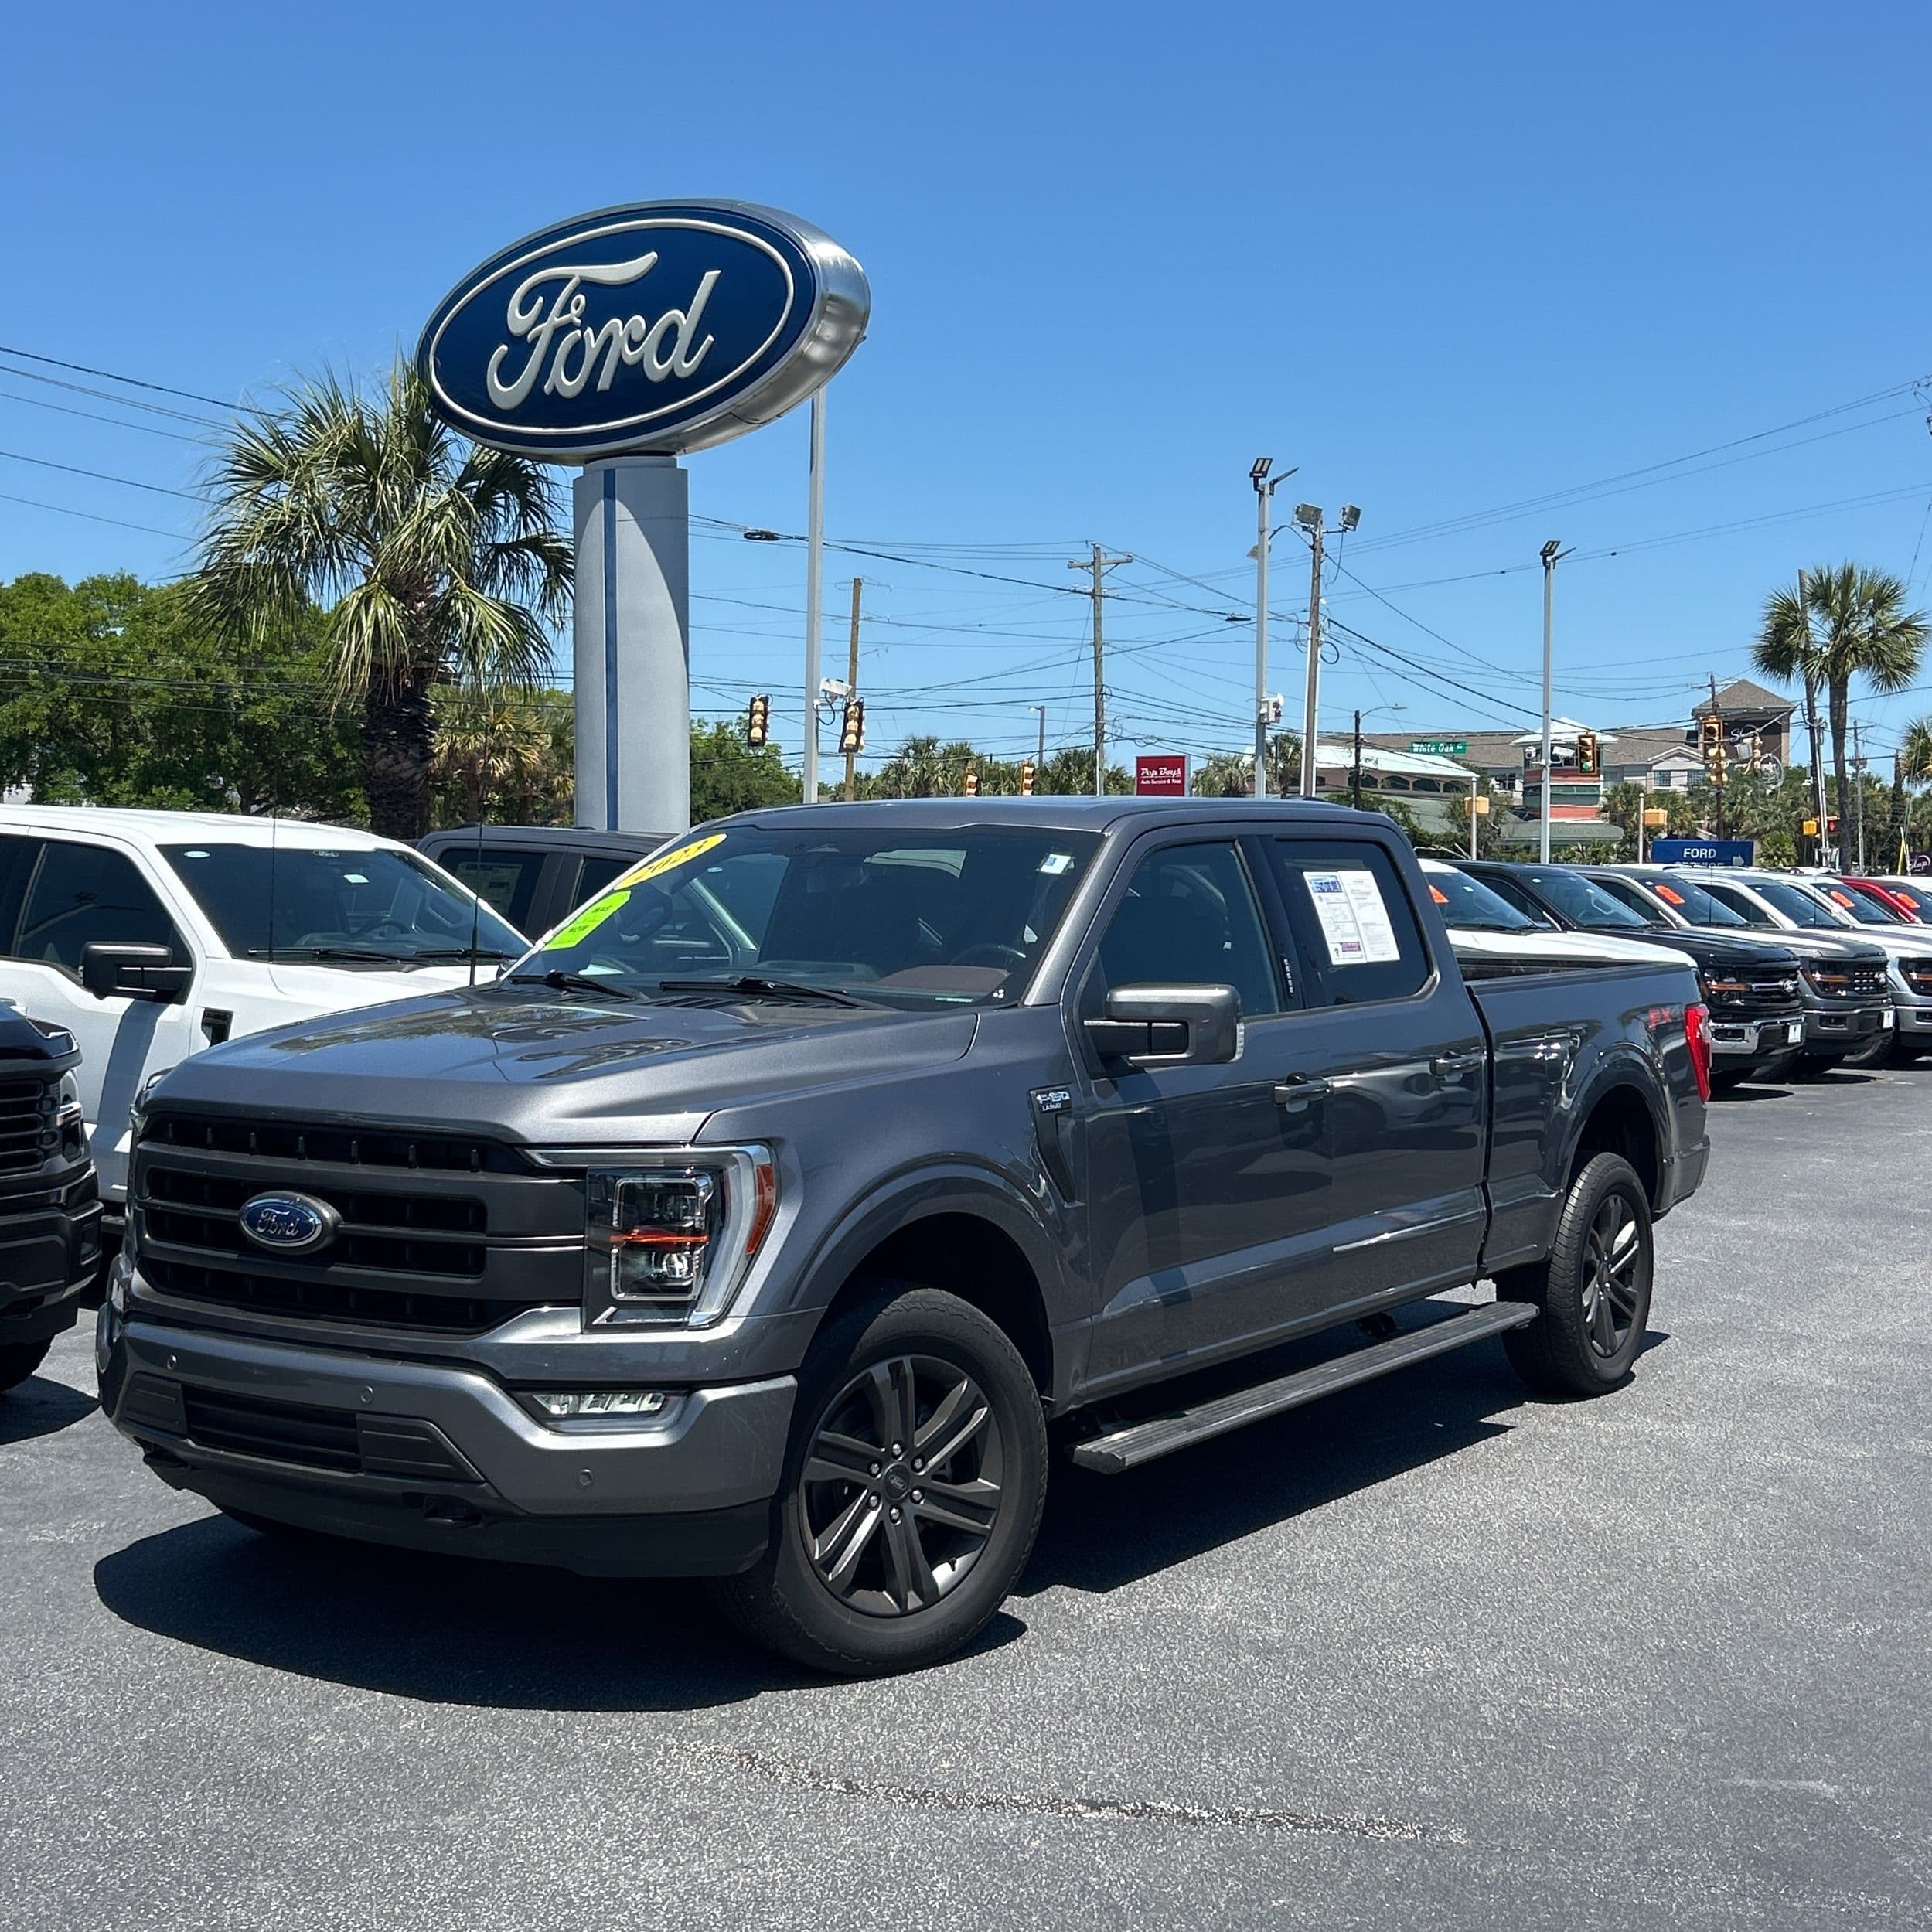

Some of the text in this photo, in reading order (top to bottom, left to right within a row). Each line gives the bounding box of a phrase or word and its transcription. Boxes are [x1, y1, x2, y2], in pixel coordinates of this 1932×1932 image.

[486, 250, 721, 411] Ford
[1158, 767, 1181, 778] Boys
[1683, 848, 1716, 859] FORD
[257, 1208, 300, 1236] Ford
